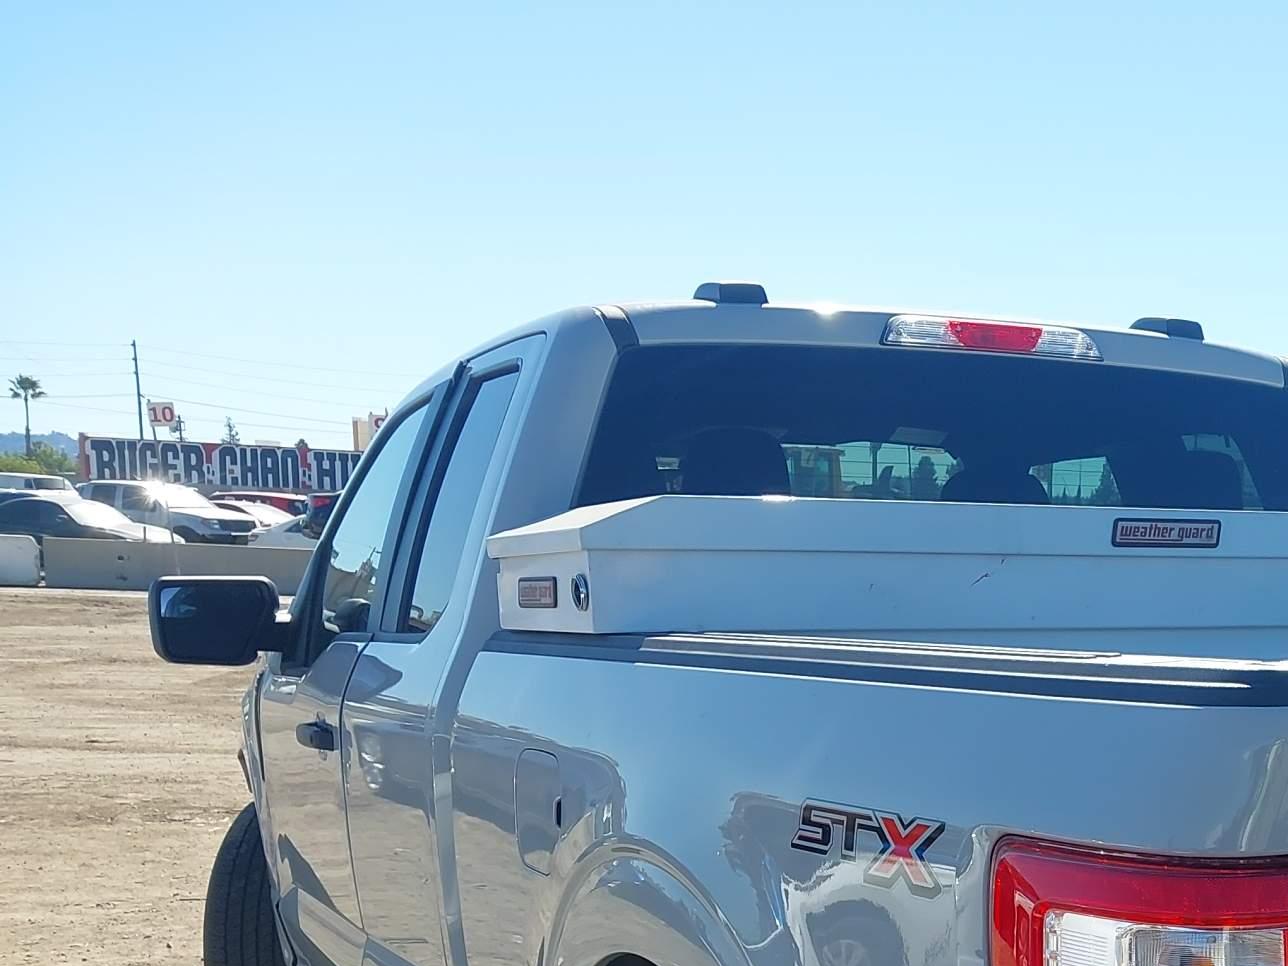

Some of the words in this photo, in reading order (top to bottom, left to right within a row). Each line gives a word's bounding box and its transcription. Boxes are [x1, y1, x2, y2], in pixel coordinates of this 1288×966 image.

[150, 406, 174, 423] 10
[1119, 523, 1176, 539] weather
[1177, 525, 1215, 540] guard
[790, 797, 947, 900] STX
